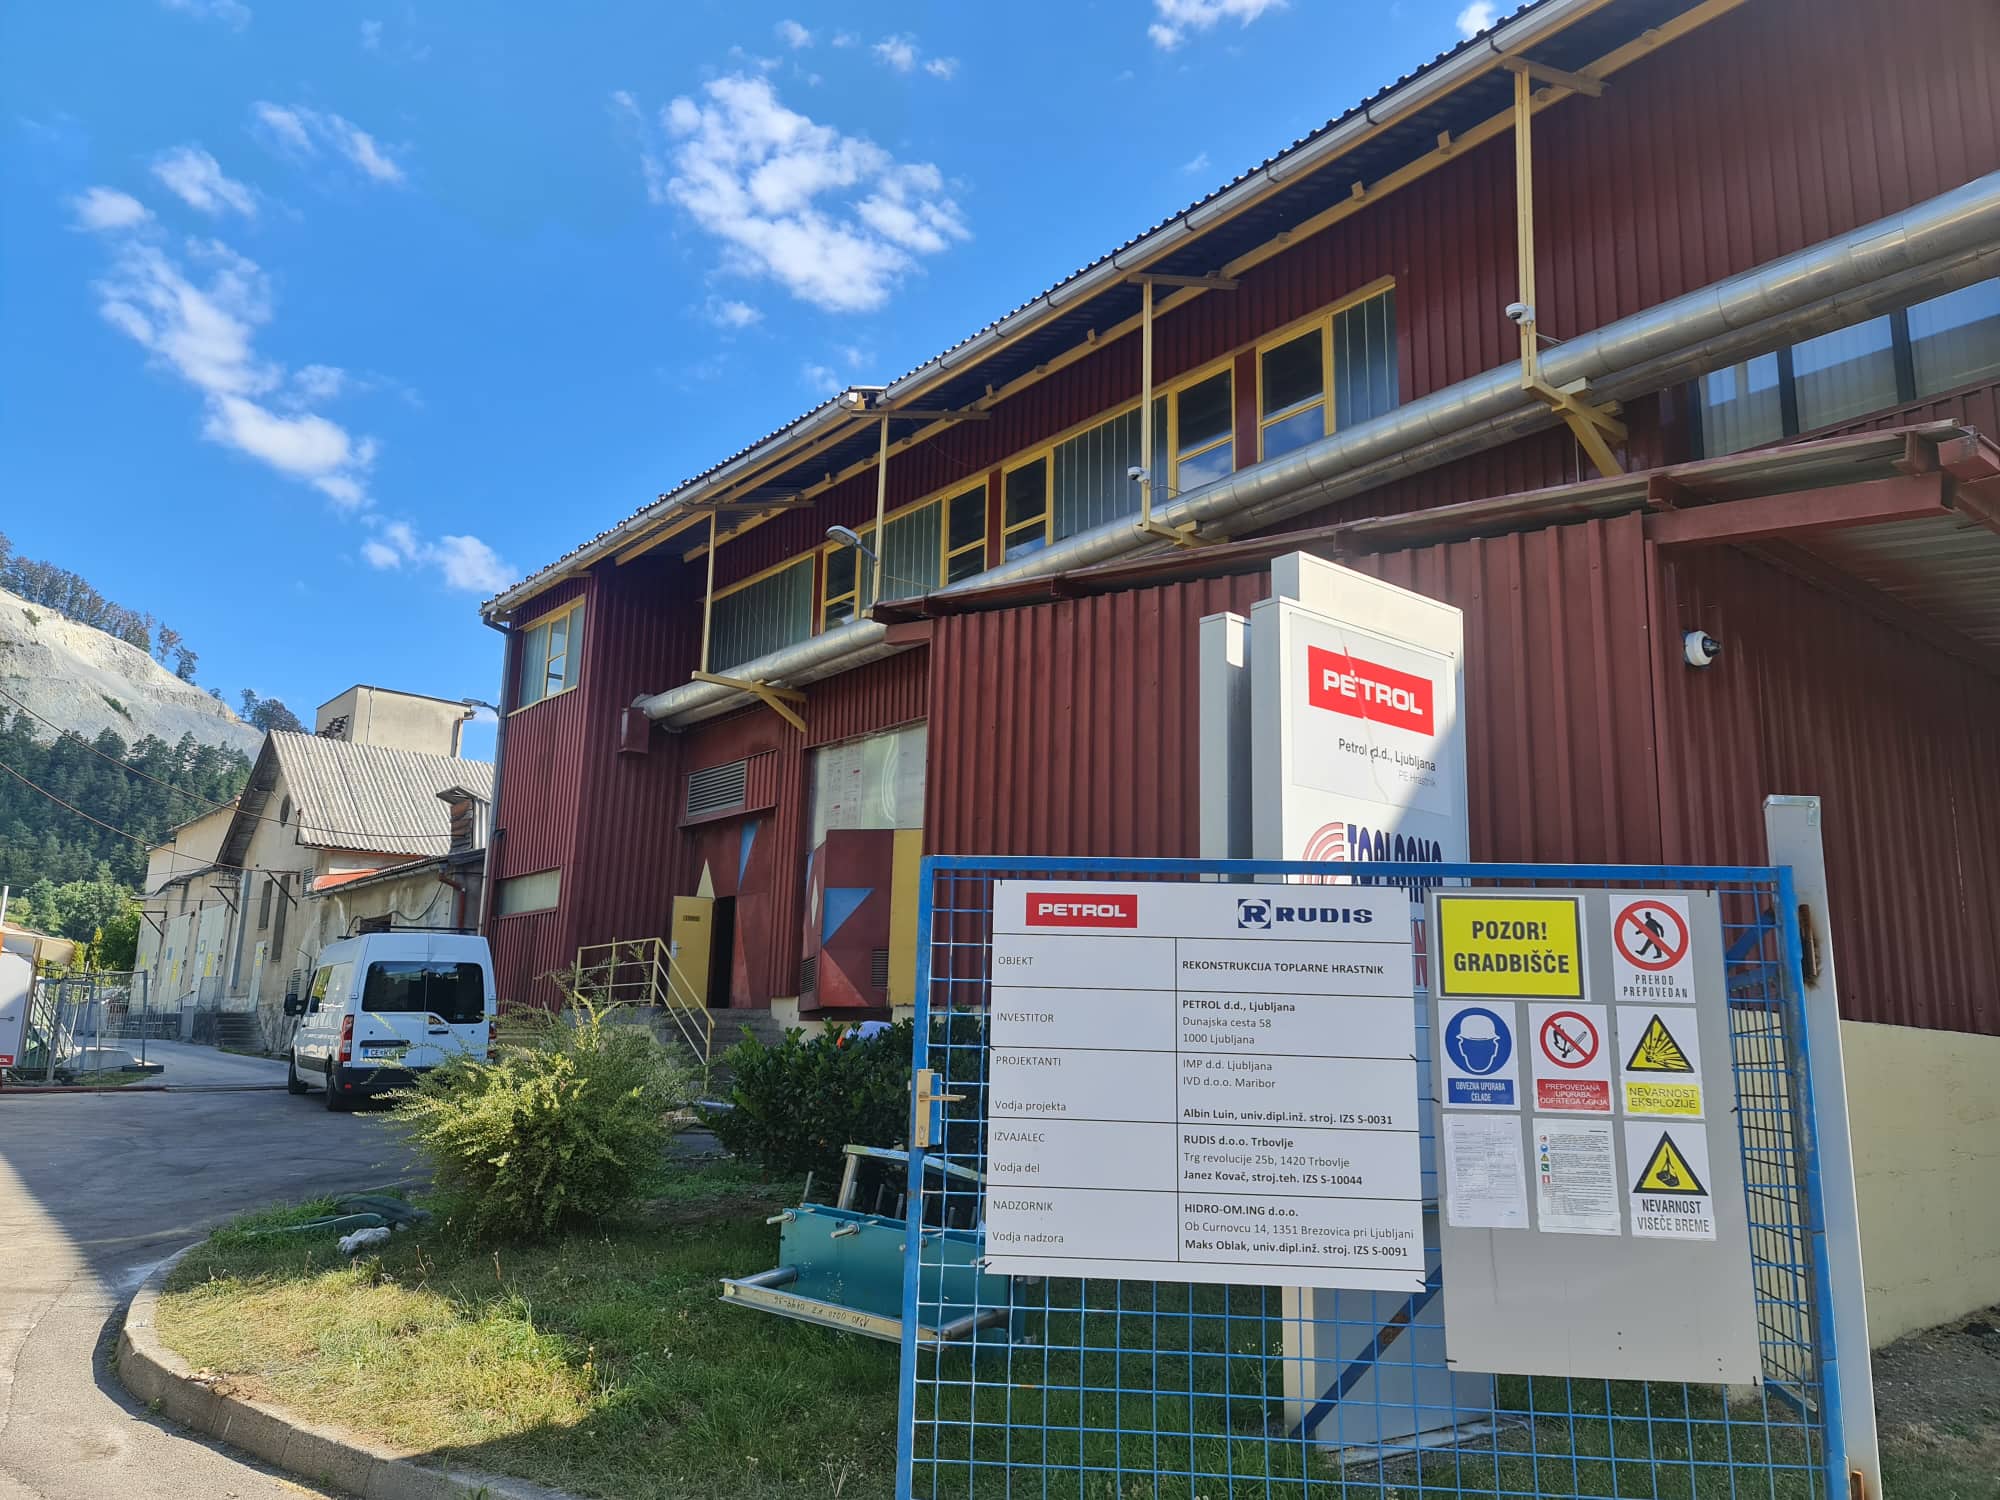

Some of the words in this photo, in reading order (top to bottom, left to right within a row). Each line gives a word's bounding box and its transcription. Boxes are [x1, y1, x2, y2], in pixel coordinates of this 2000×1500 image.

[1323, 668, 1423, 715] PETROL
[1339, 738, 1367, 756] Petrol
[1395, 750, 1436, 771] Ljubljana
[1038, 903, 1126, 918] PETROL
[1276, 906, 1372, 923] RUDIS
[1472, 921, 1547, 940] POZOR!
[998, 956, 1032, 965] OBJEKT
[1454, 950, 1569, 973] GRADBIŠČE
[1183, 960, 1271, 973] REKONSTRUKCIJA
[1275, 962, 1328, 973] TOPLARNE
[1331, 963, 1384, 974] HRASTNIK
[1635, 975, 1674, 985] PREHOD
[1623, 986, 1688, 998] PREPOVEDAN
[1183, 1000, 1220, 1011] PETROL
[1224, 1001, 1246, 1012] d.d.,
[1249, 1002, 1295, 1013] Ljubljana
[997, 1013, 1054, 1023] INVESTITOR
[1183, 1017, 1227, 1028] Dunajska
[1231, 1019, 1256, 1028] cesta
[1260, 1019, 1271, 1028] 58
[1183, 1034, 1206, 1043] 1000
[1210, 1035, 1255, 1046] Ljubljana
[996, 1056, 1060, 1067] PROJEKTANTI
[1183, 1059, 1202, 1069] IMP
[1206, 1060, 1224, 1070] d.d.
[1227, 1061, 1272, 1071] Ljubljana
[1183, 1077, 1200, 1086] IVD
[1204, 1077, 1231, 1087] d.o.o.
[1235, 1079, 1275, 1088] Maribor
[1456, 1082, 1480, 1090] OBVEZNA
[1480, 1082, 1505, 1091] UPORABA
[1545, 1083, 1600, 1091] PREPOVEDANA
[1471, 1092, 1492, 1102] ČELADE
[1629, 1087, 1696, 1098] NEVARNOST
[995, 1101, 1022, 1112] Vodja
[1026, 1102, 1066, 1113] projekta
[1631, 1098, 1696, 1109] EKSPLOZIJE
[1184, 1109, 1209, 1119] Albin
[1212, 1110, 1237, 1121] Luin,
[1241, 1110, 1306, 1122] univ.dipl.inž.
[1309, 1113, 1336, 1124] stroj.
[1339, 1115, 1354, 1124] IZS
[1357, 1115, 1392, 1125] S-0031
[994, 1133, 1045, 1142] IZVAJALEC
[1184, 1136, 1215, 1146] RUDIS
[1219, 1136, 1248, 1147] d.o.o.
[1251, 1137, 1293, 1149] Trbovlje
[1184, 1154, 1199, 1164] Trg
[1203, 1154, 1251, 1166] revolucije
[1255, 1156, 1277, 1166] 25b,
[1281, 1157, 1305, 1166] 1420
[1309, 1157, 1350, 1168] Trbovlje
[994, 1163, 1021, 1173] Vodja
[1025, 1163, 1039, 1172] del
[1184, 1170, 1212, 1181] Janez
[1216, 1171, 1248, 1182] Kovač,
[1252, 1173, 1299, 1184] stroj.teh.
[1303, 1175, 1317, 1184] IZS
[1321, 1175, 1362, 1185] S-10044
[993, 1201, 1053, 1211] NADZORNIK
[1185, 1205, 1264, 1216] HIDRO-OM.ING
[1268, 1206, 1298, 1217] d.o.o.
[1642, 1199, 1701, 1214] NEVARNOST
[1637, 1216, 1673, 1231] VISEČE
[1675, 1219, 1709, 1232] BREME
[1185, 1221, 1199, 1231] Ob
[1255, 1224, 1270, 1235] 14,
[1273, 1224, 1297, 1235] 1351
[1301, 1225, 1350, 1237] Brezovica
[1353, 1227, 1367, 1239] pri
[1370, 1227, 1414, 1240] Ljubljani
[993, 1232, 1020, 1242] Vodja
[1023, 1233, 1063, 1243] nadzora
[1185, 1239, 1213, 1249] Maks
[1216, 1240, 1249, 1251] Oblak,
[1252, 1242, 1318, 1253] univ.dipl.inž.
[1321, 1244, 1350, 1255] stroj.
[1353, 1246, 1368, 1256] IZS
[1372, 1247, 1408, 1256] S-0091
